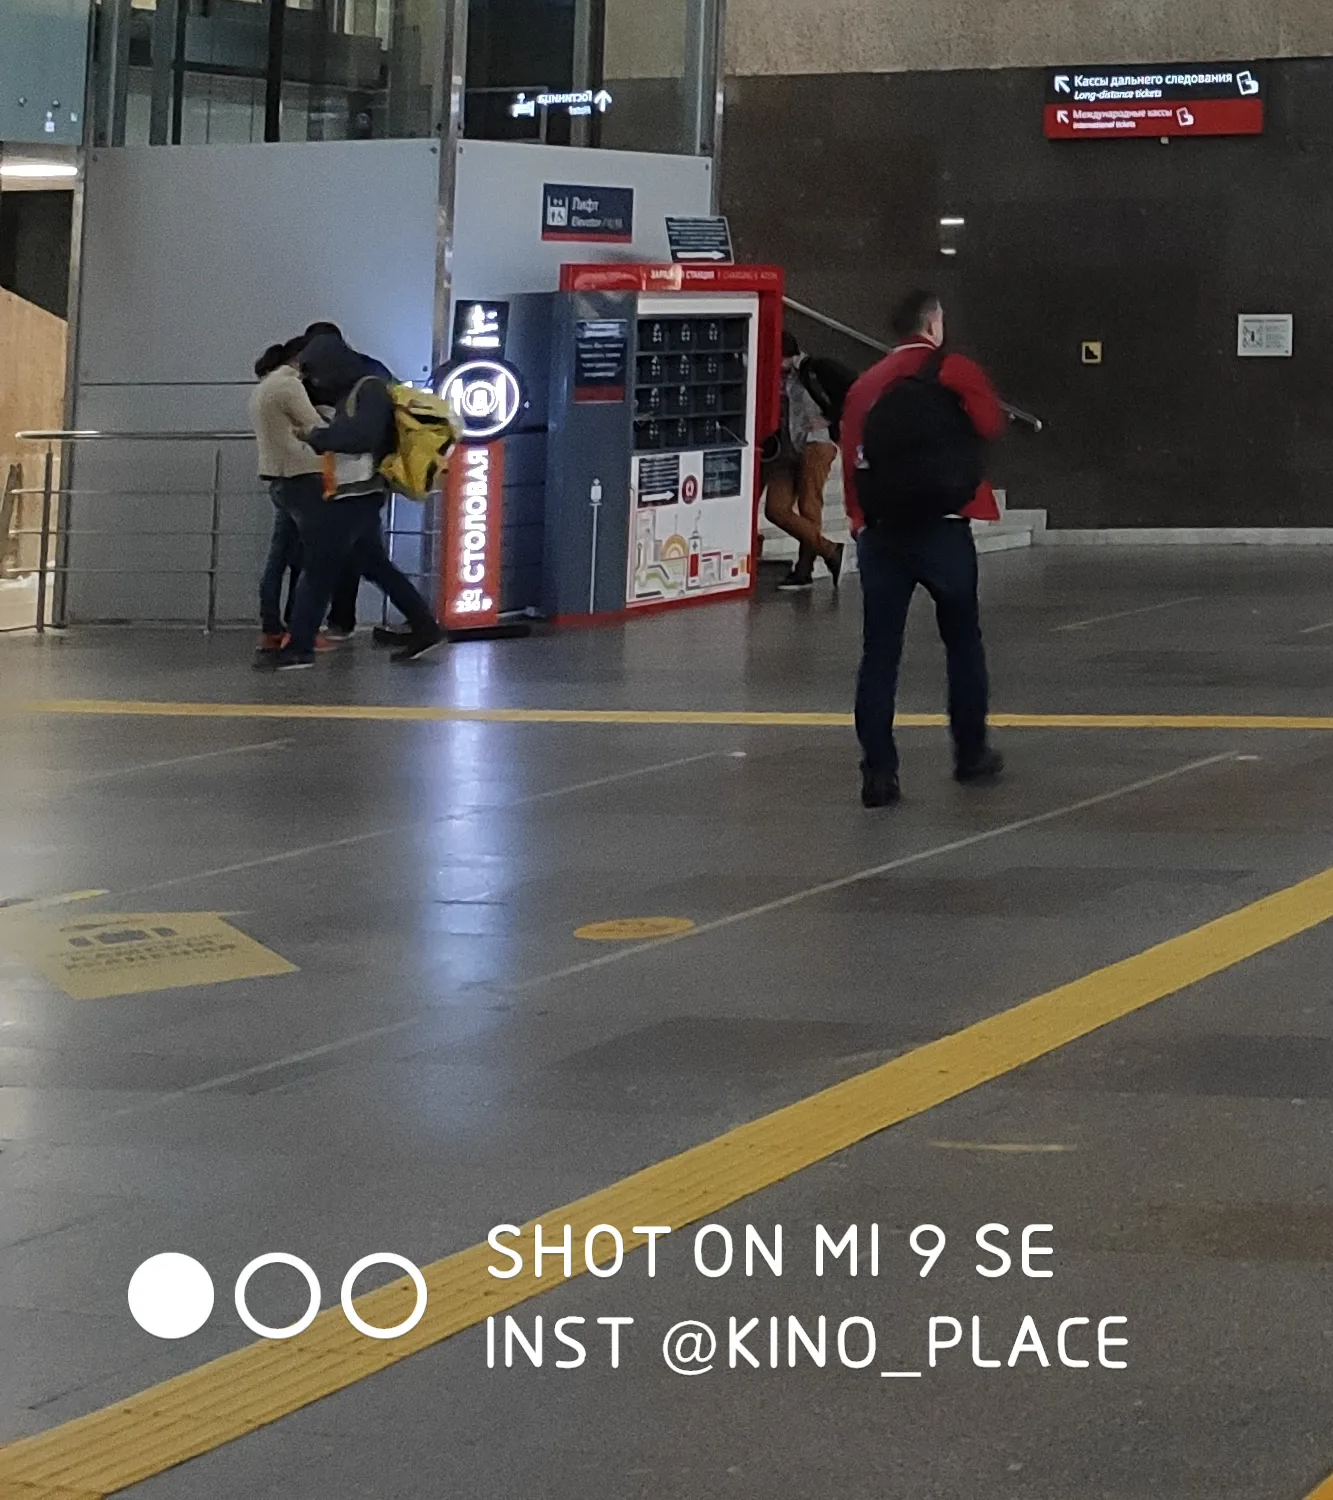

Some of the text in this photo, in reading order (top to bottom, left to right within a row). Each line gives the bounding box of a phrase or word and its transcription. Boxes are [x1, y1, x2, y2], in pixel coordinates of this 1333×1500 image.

[1074, 73, 1233, 88] Кассы дальнего следования
[1074, 89, 1162, 101] Long-distance tickets
[462, 447, 490, 584] СТОЛОВАЯ
